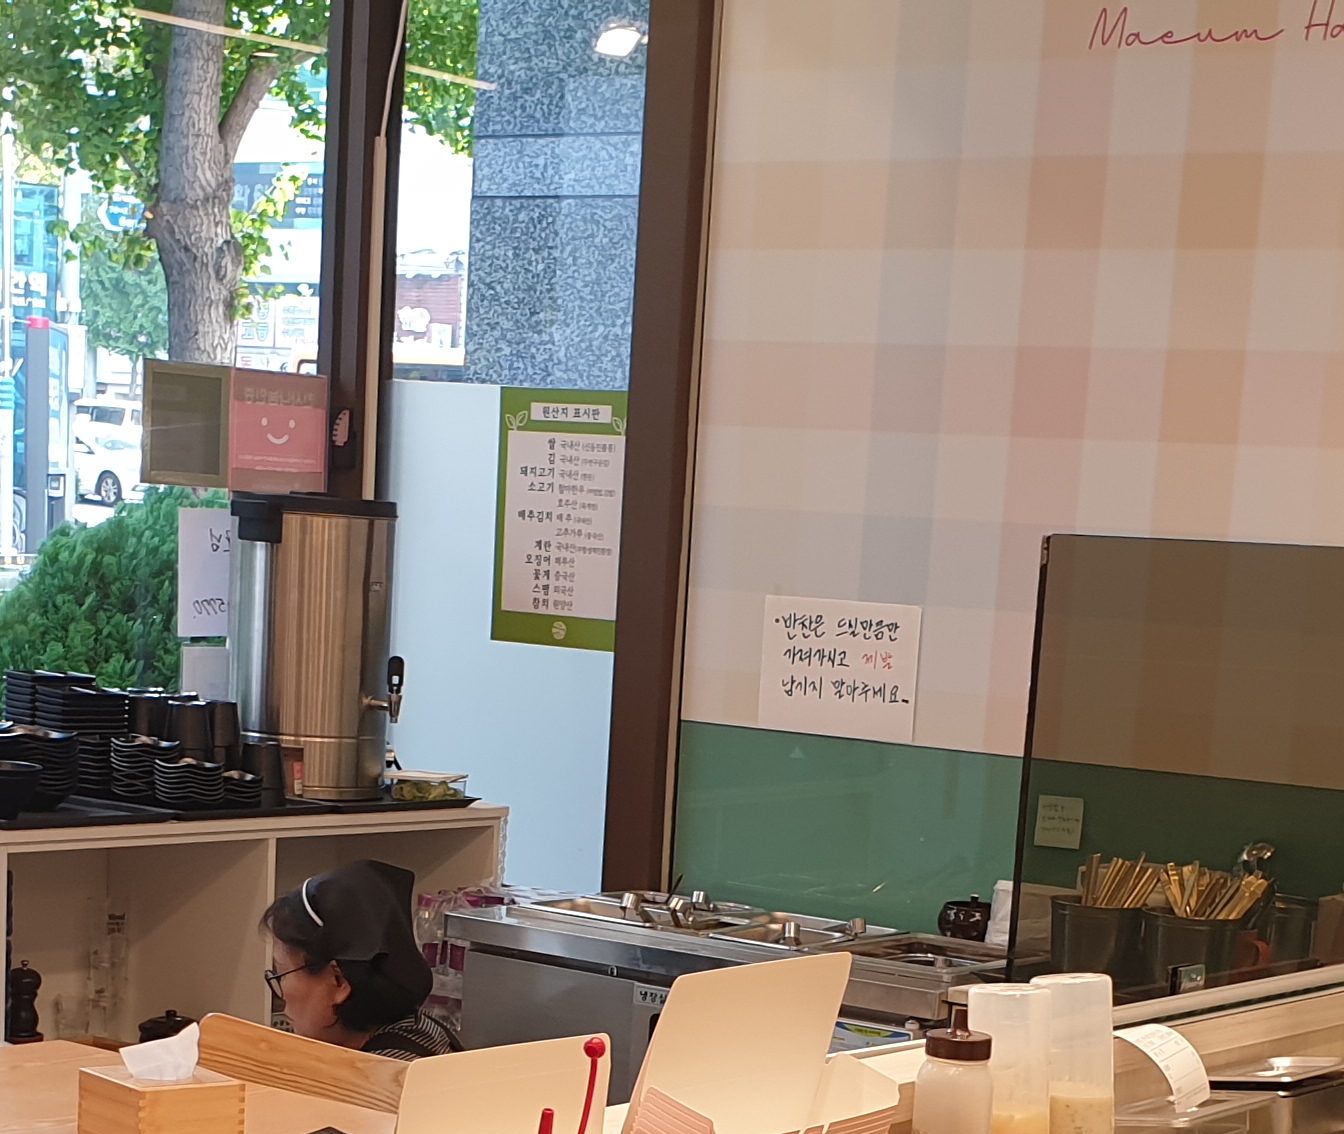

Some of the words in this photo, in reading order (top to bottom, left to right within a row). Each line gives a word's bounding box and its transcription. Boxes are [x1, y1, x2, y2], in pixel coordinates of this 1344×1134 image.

[1087, 6, 1285, 50] Maeum
[542, 405, 569, 419] 원산지
[572, 407, 601, 421] 표시판
[547, 438, 556, 451] 쌀
[560, 440, 581, 452] 국내산
[548, 453, 556, 465] 김
[559, 454, 580, 467] 국내산
[519, 465, 555, 478] 돼지고기
[558, 469, 580, 481] 국내산
[527, 482, 555, 493] 소고기
[517, 509, 553, 523] 배추김치
[534, 540, 552, 553] 계란
[524, 553, 551, 566] 오징어
[532, 568, 551, 581] 꽃게
[532, 583, 550, 596] 스팸
[532, 597, 549, 610] 참치
[781, 612, 826, 641] 반찬은
[783, 645, 850, 669] 가져가시고
[861, 650, 894, 670] 제발
[781, 674, 823, 700] 남기지
